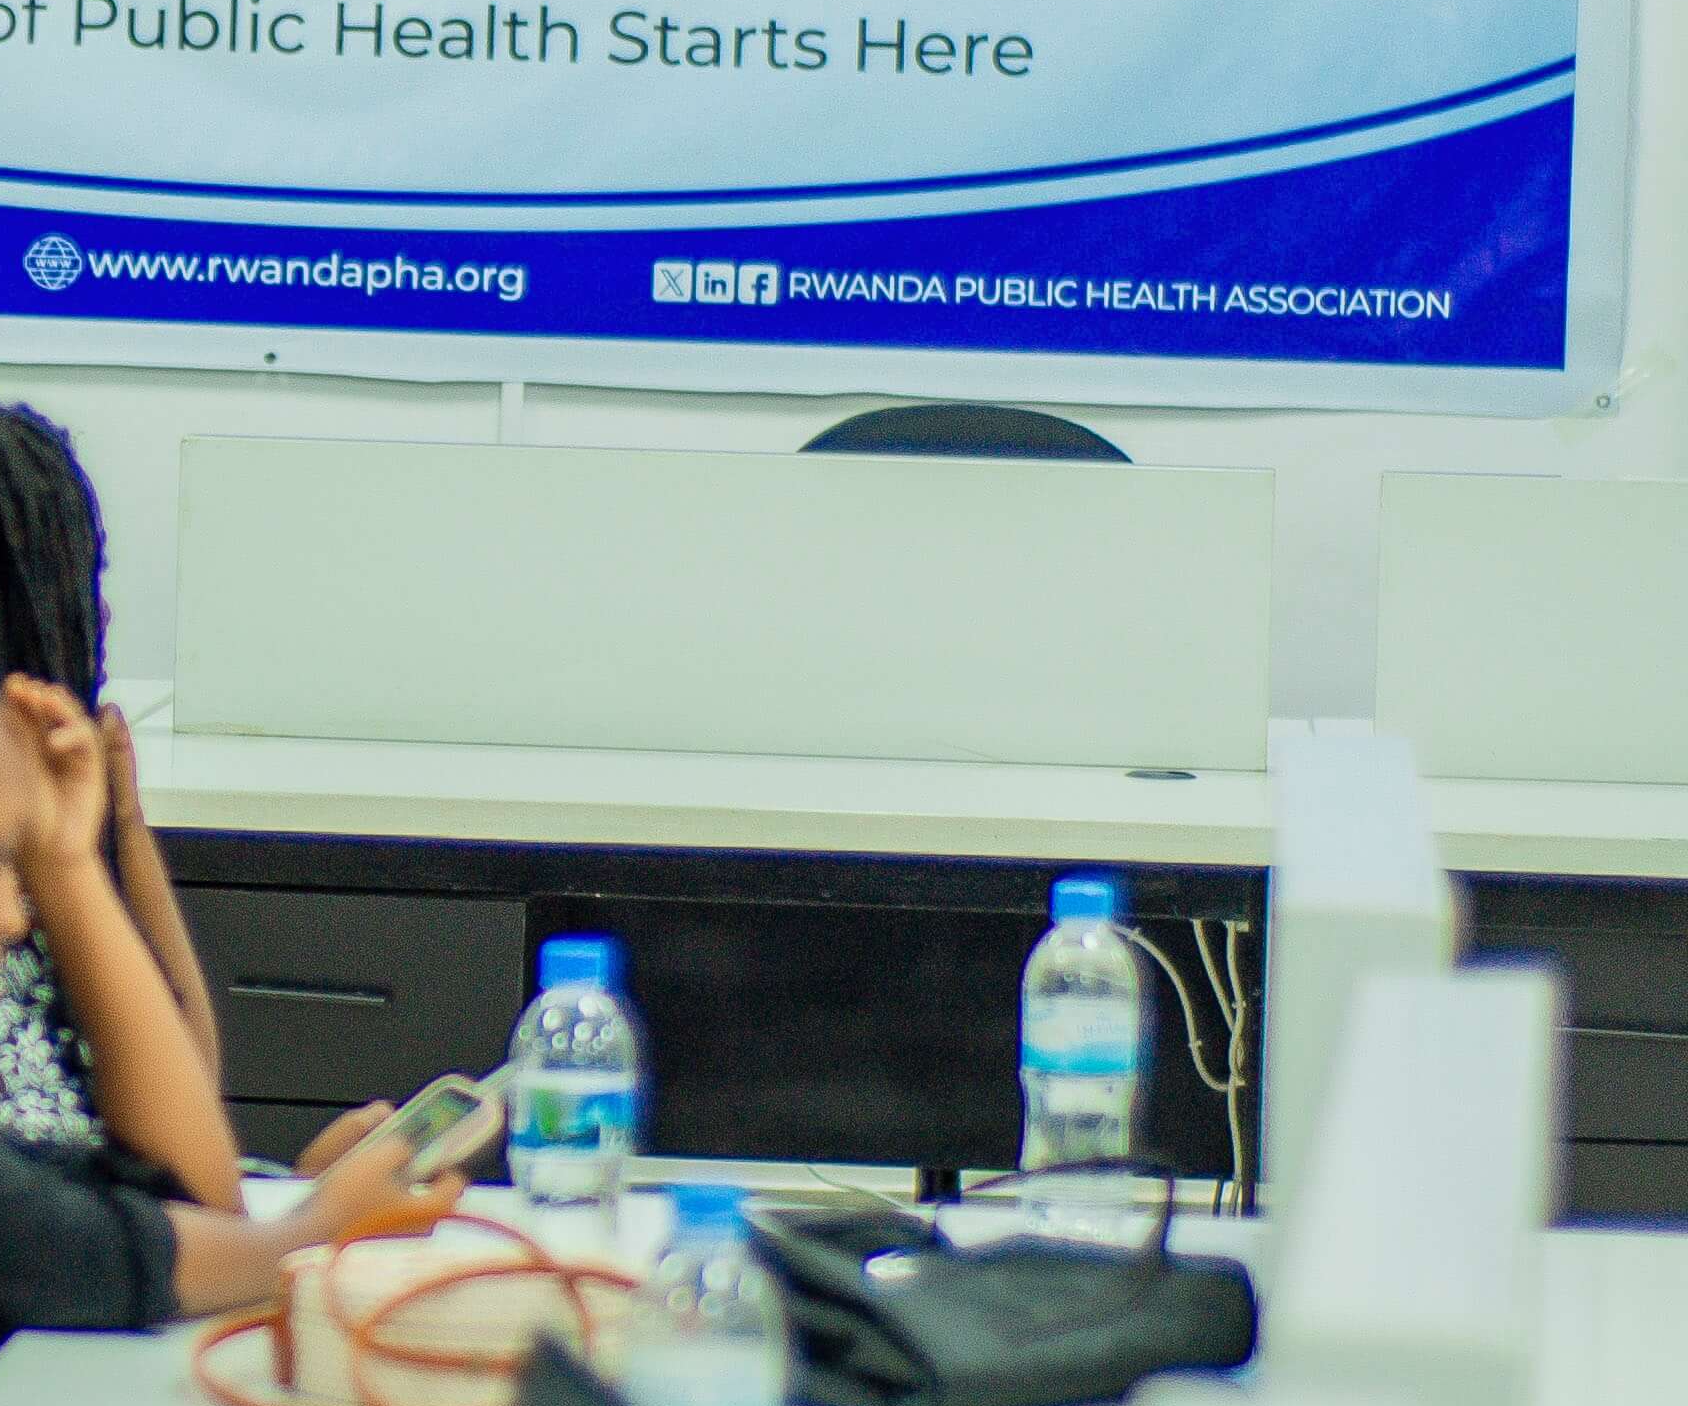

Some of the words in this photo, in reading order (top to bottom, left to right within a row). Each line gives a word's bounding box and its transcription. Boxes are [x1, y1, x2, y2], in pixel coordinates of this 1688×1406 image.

[336, 2, 579, 63] Health
[608, 10, 828, 71] Starts
[857, 17, 1034, 77] Here
[87, 249, 525, 301] www.rwandapha.org
[789, 272, 947, 304] RWANDA
[955, 277, 1078, 308] PUBLIC
[1086, 282, 1217, 311] HEALTH
[1224, 286, 1452, 320] ASSOCIATION
